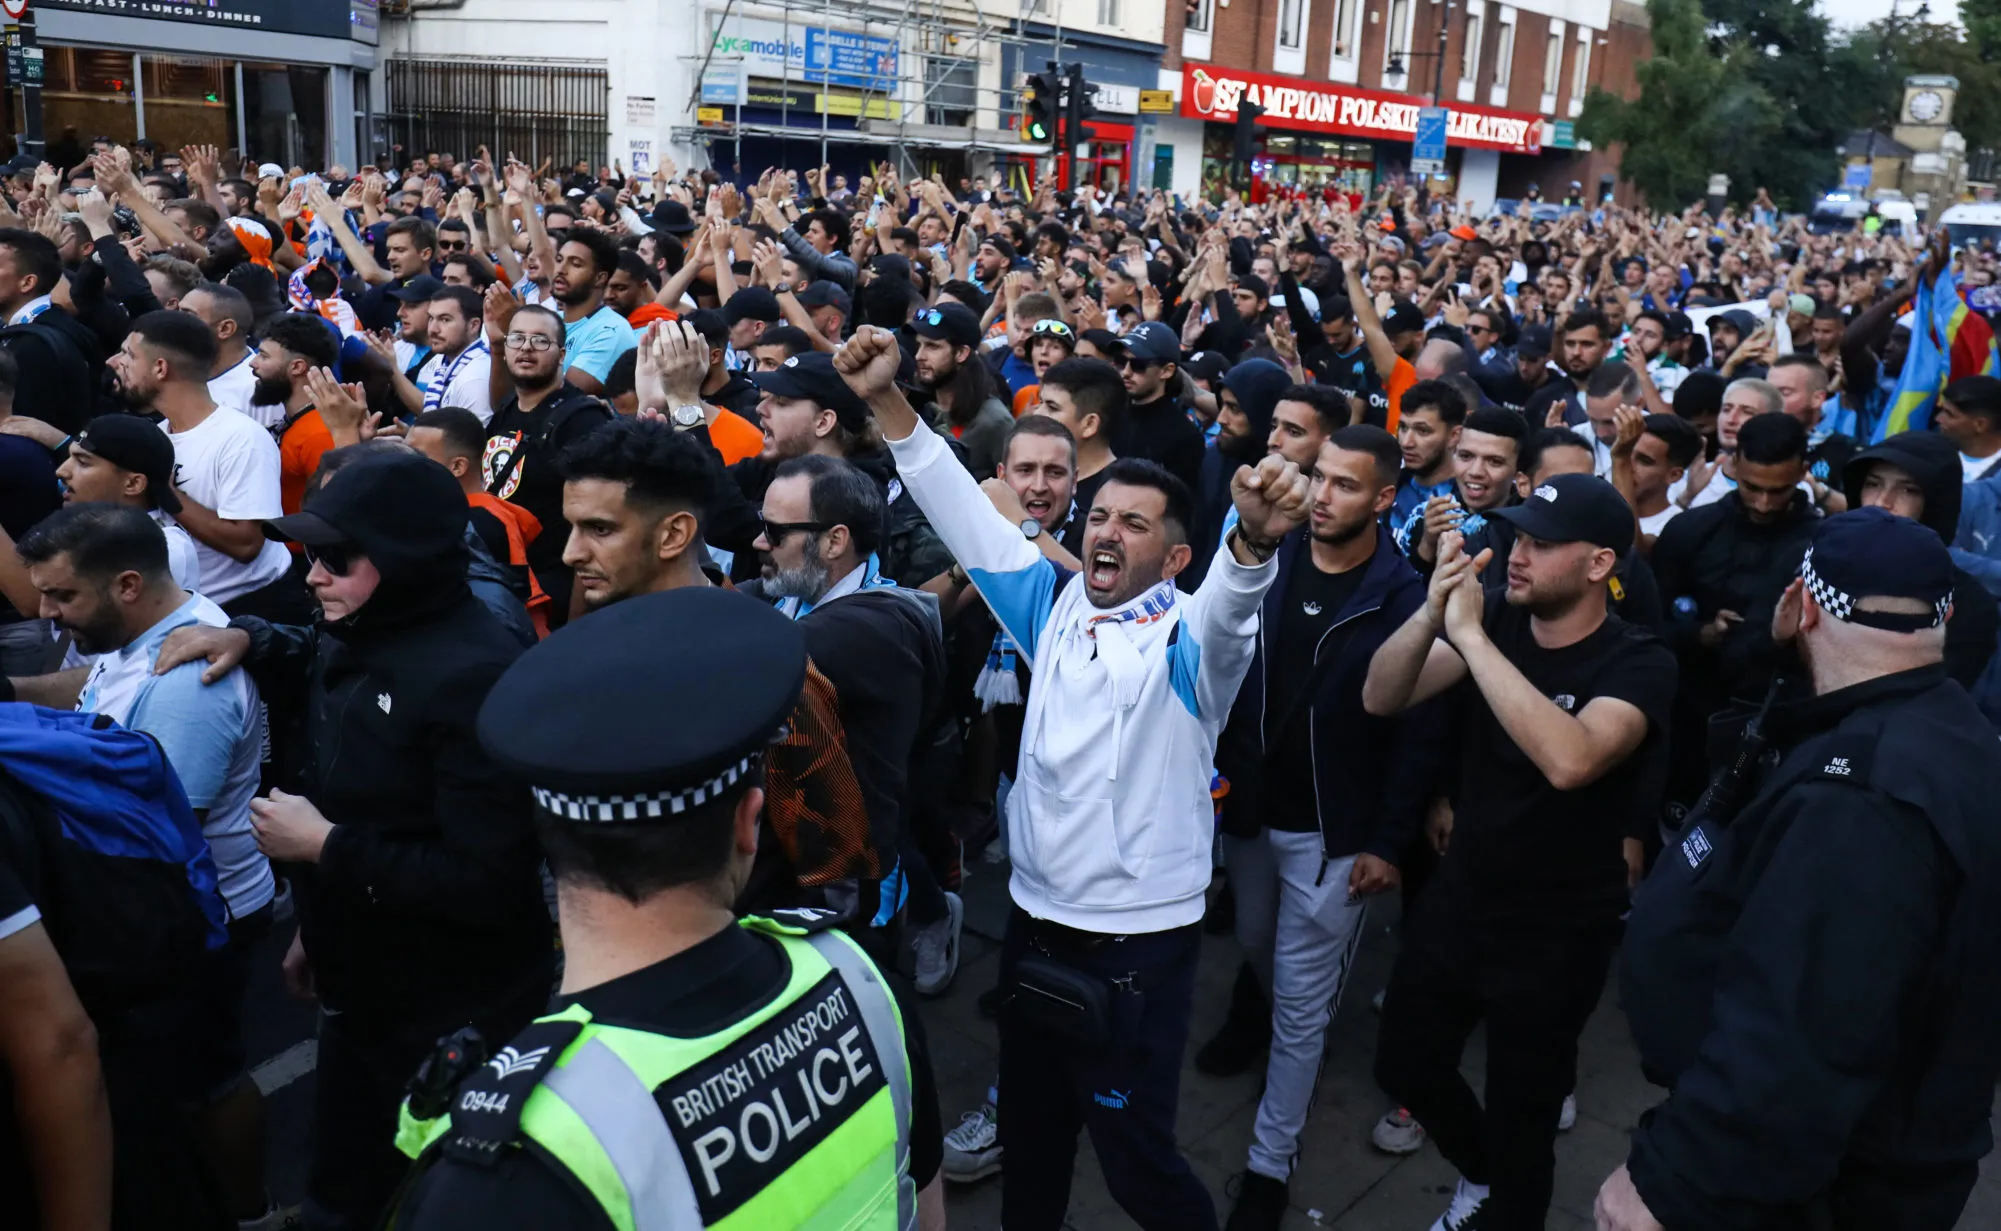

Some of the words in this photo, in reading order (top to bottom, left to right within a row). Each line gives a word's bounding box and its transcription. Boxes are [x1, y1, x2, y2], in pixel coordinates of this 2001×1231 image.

[142, 3, 194, 16] LUNCH
[206, 10, 262, 24] DINNER
[712, 30, 803, 58] Lycamoble
[630, 140, 651, 150] MOT
[1823, 765, 1851, 776] 1252
[1831, 757, 1849, 767] NE
[672, 1058, 754, 1128] BRITISH
[748, 987, 849, 1080] TRANSPORT
[461, 1089, 511, 1114] 0944
[692, 1025, 873, 1197] POLICE
[1093, 1092, 1124, 1109] PUMA
